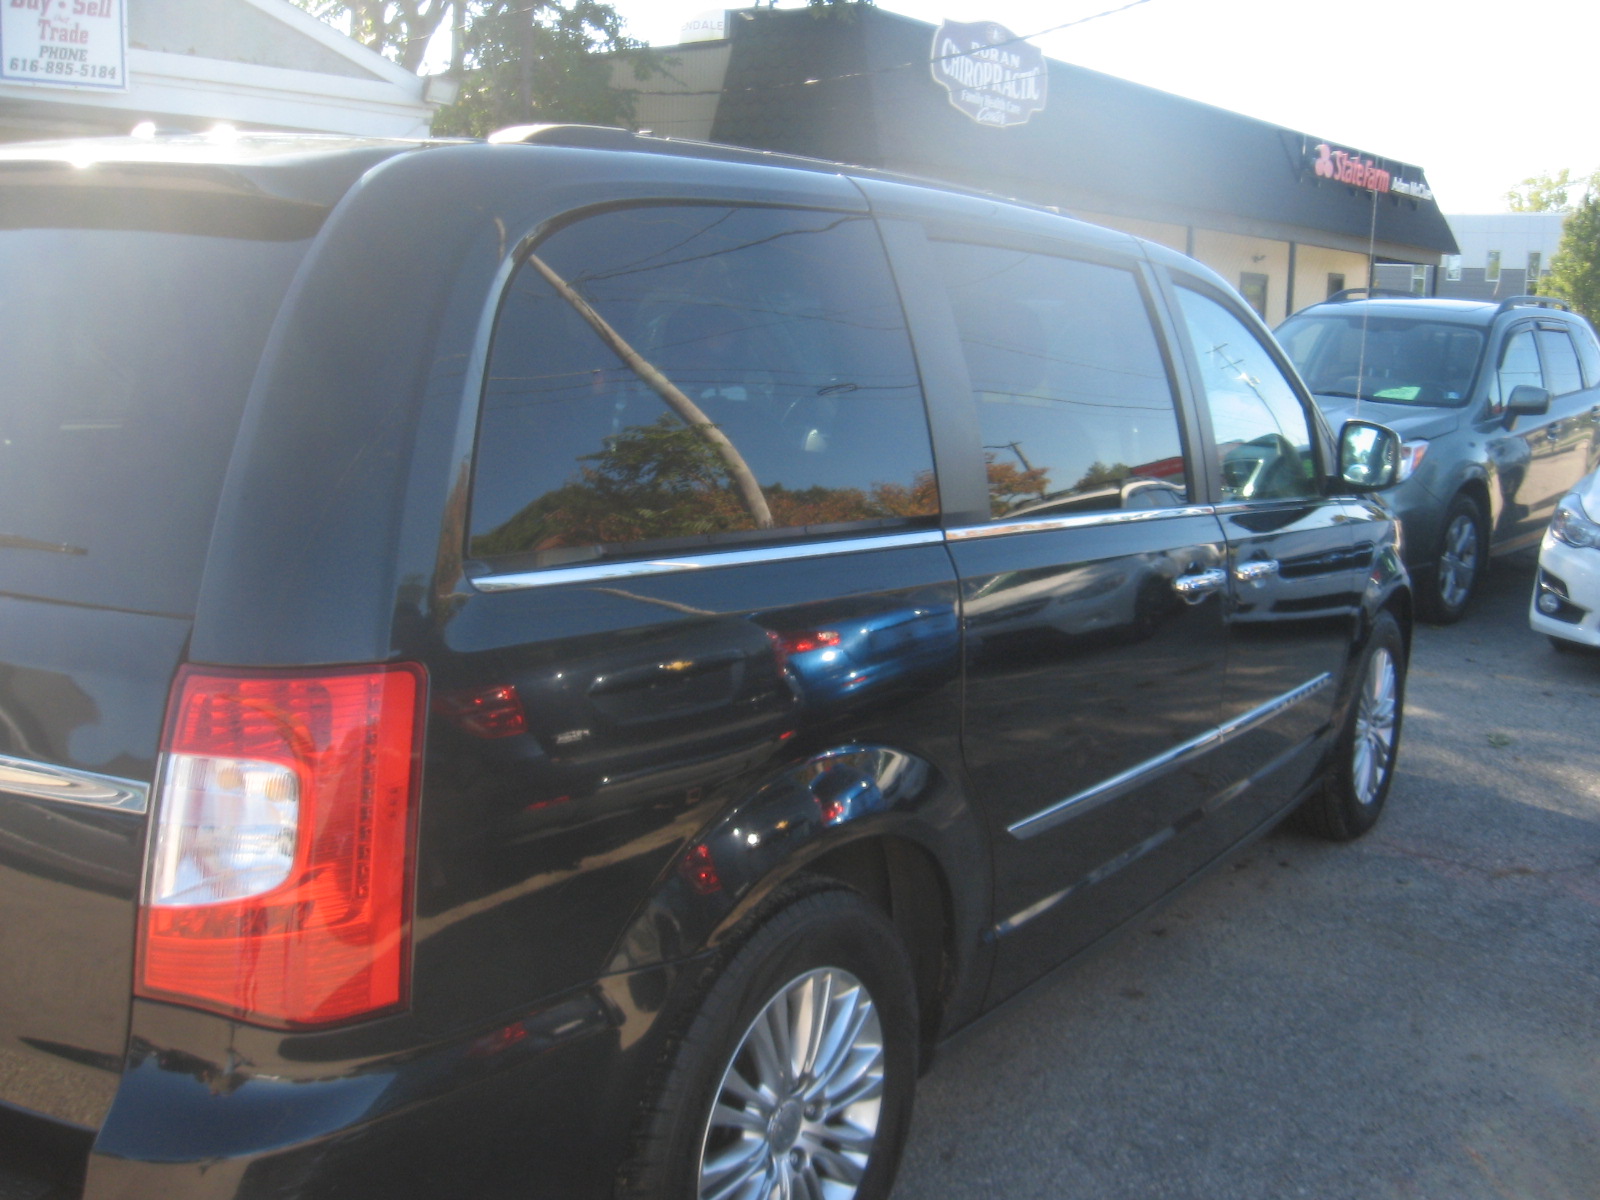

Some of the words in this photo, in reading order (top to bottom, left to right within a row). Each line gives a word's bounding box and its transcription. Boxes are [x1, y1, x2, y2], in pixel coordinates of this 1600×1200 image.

[72, 0, 112, 18] Sell
[38, 18, 89, 44] Trade
[39, 45, 89, 62] PHONE
[9, 57, 117, 80] 616-895-5184
[941, 37, 1041, 101] CHIROPRACTIC
